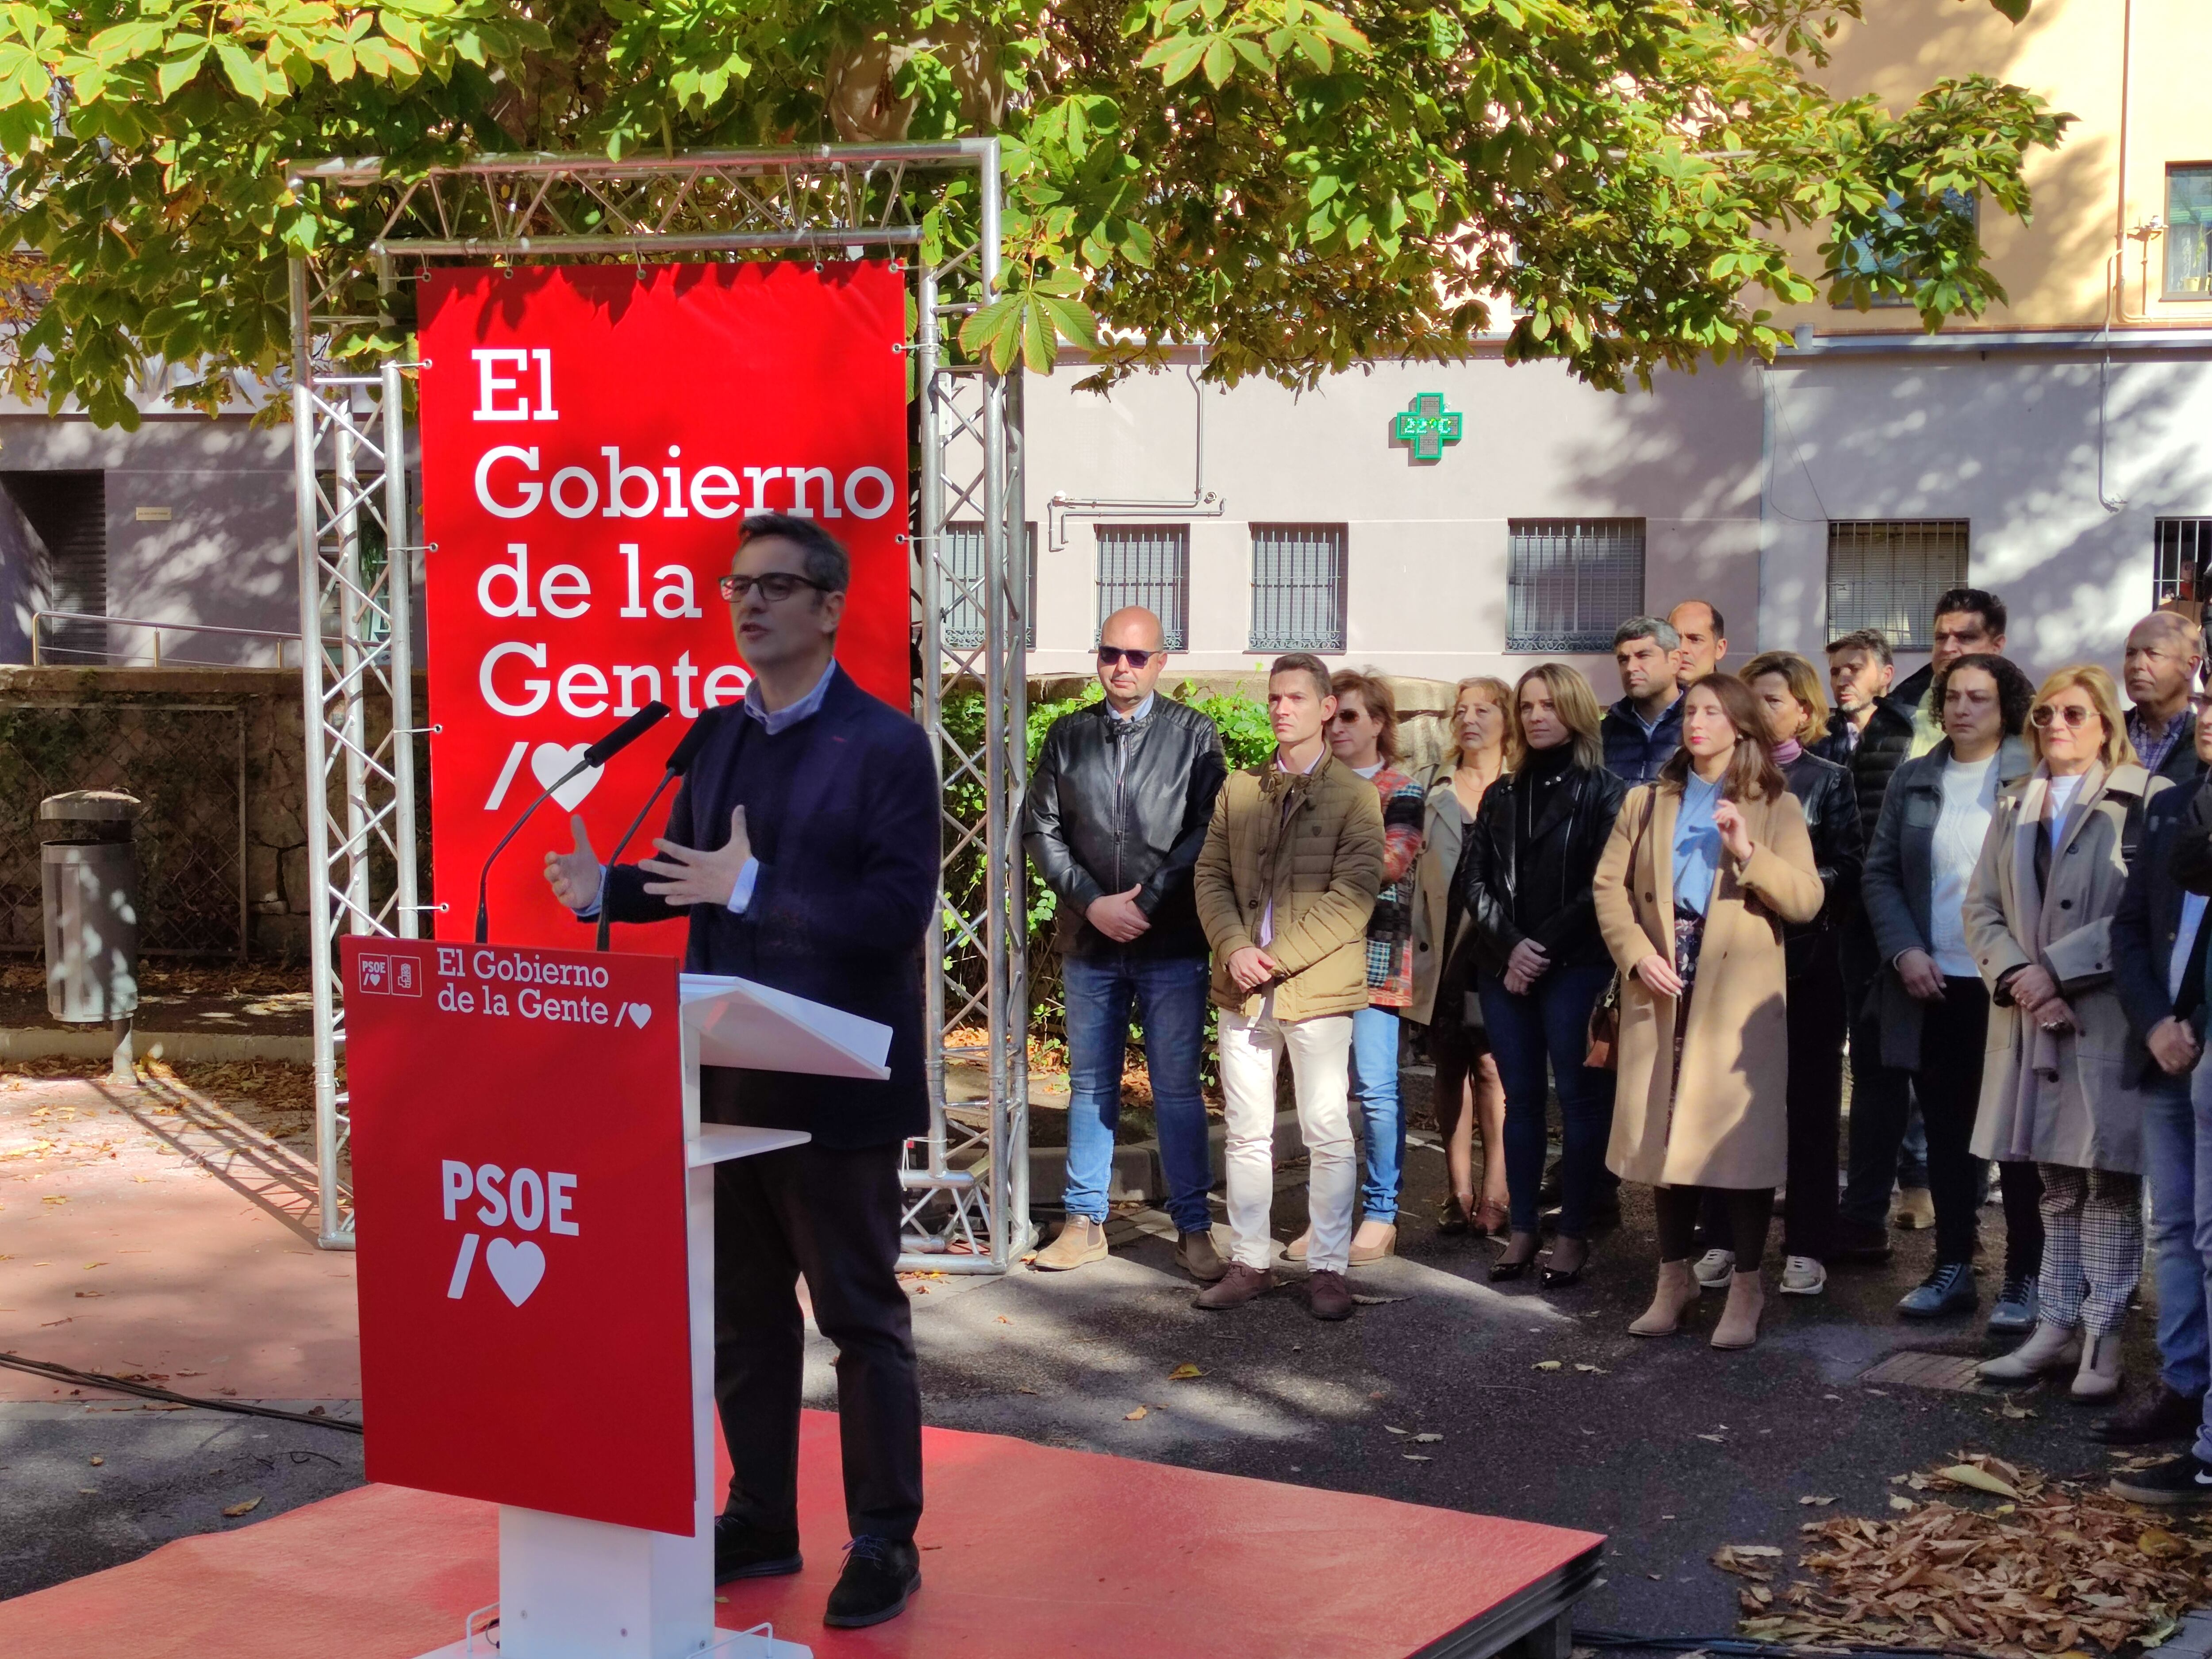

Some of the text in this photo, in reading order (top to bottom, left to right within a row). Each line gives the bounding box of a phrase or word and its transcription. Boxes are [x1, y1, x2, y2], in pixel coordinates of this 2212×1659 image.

[471, 349, 559, 421] El
[475, 445, 895, 519] Gobierno
[477, 543, 703, 618] de la
[479, 641, 753, 718] Gente
[362, 960, 386, 974] PSOE
[437, 947, 609, 988] El Gobierno
[438, 983, 609, 1025] de la Gente
[442, 1160, 580, 1237] PSOE
